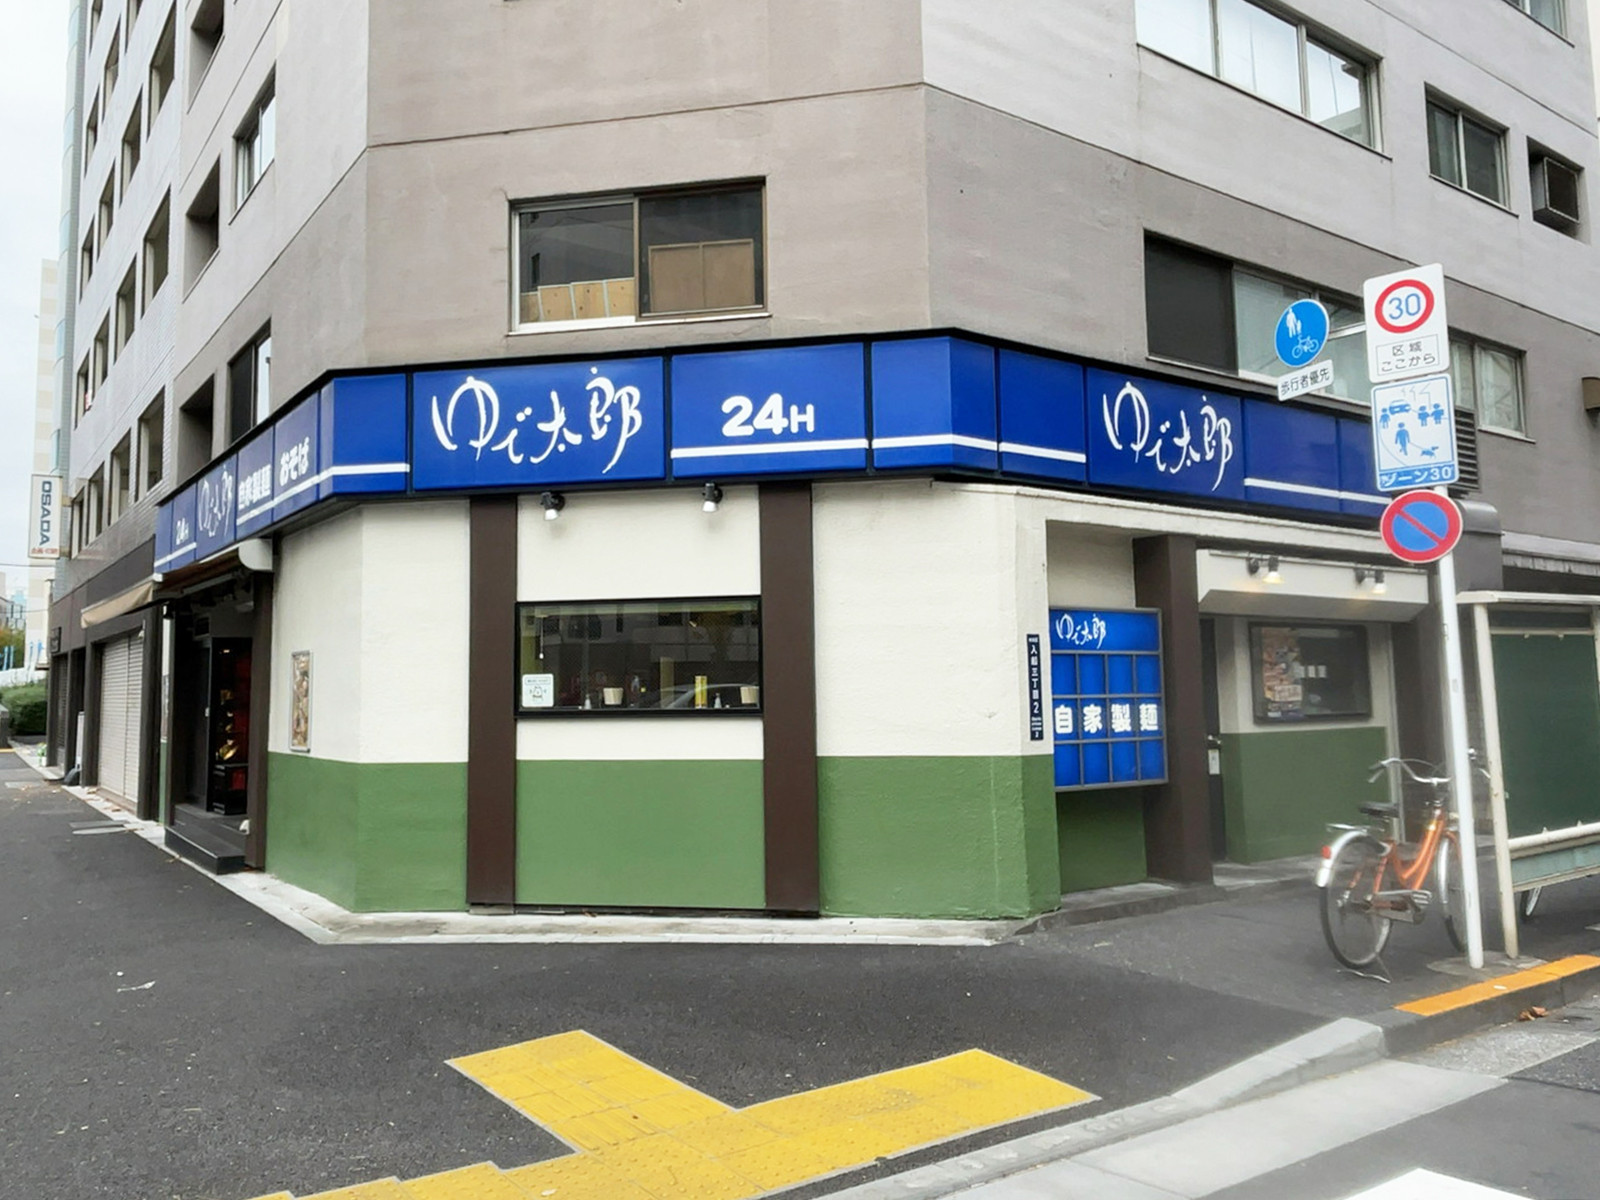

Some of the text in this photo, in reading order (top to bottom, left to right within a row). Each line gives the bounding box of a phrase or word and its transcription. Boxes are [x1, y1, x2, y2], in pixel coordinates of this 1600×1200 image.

[1389, 293, 1421, 320] 30
[1381, 353, 1436, 372] ここから
[1392, 341, 1423, 357] 区域
[1281, 368, 1330, 396] 歩行者優先
[722, 393, 815, 437] 24H
[280, 437, 310, 486] おそば
[1380, 466, 1452, 487] ゾーン30
[39, 481, 53, 546] OSADA
[1055, 703, 1159, 734] 自家製麺
